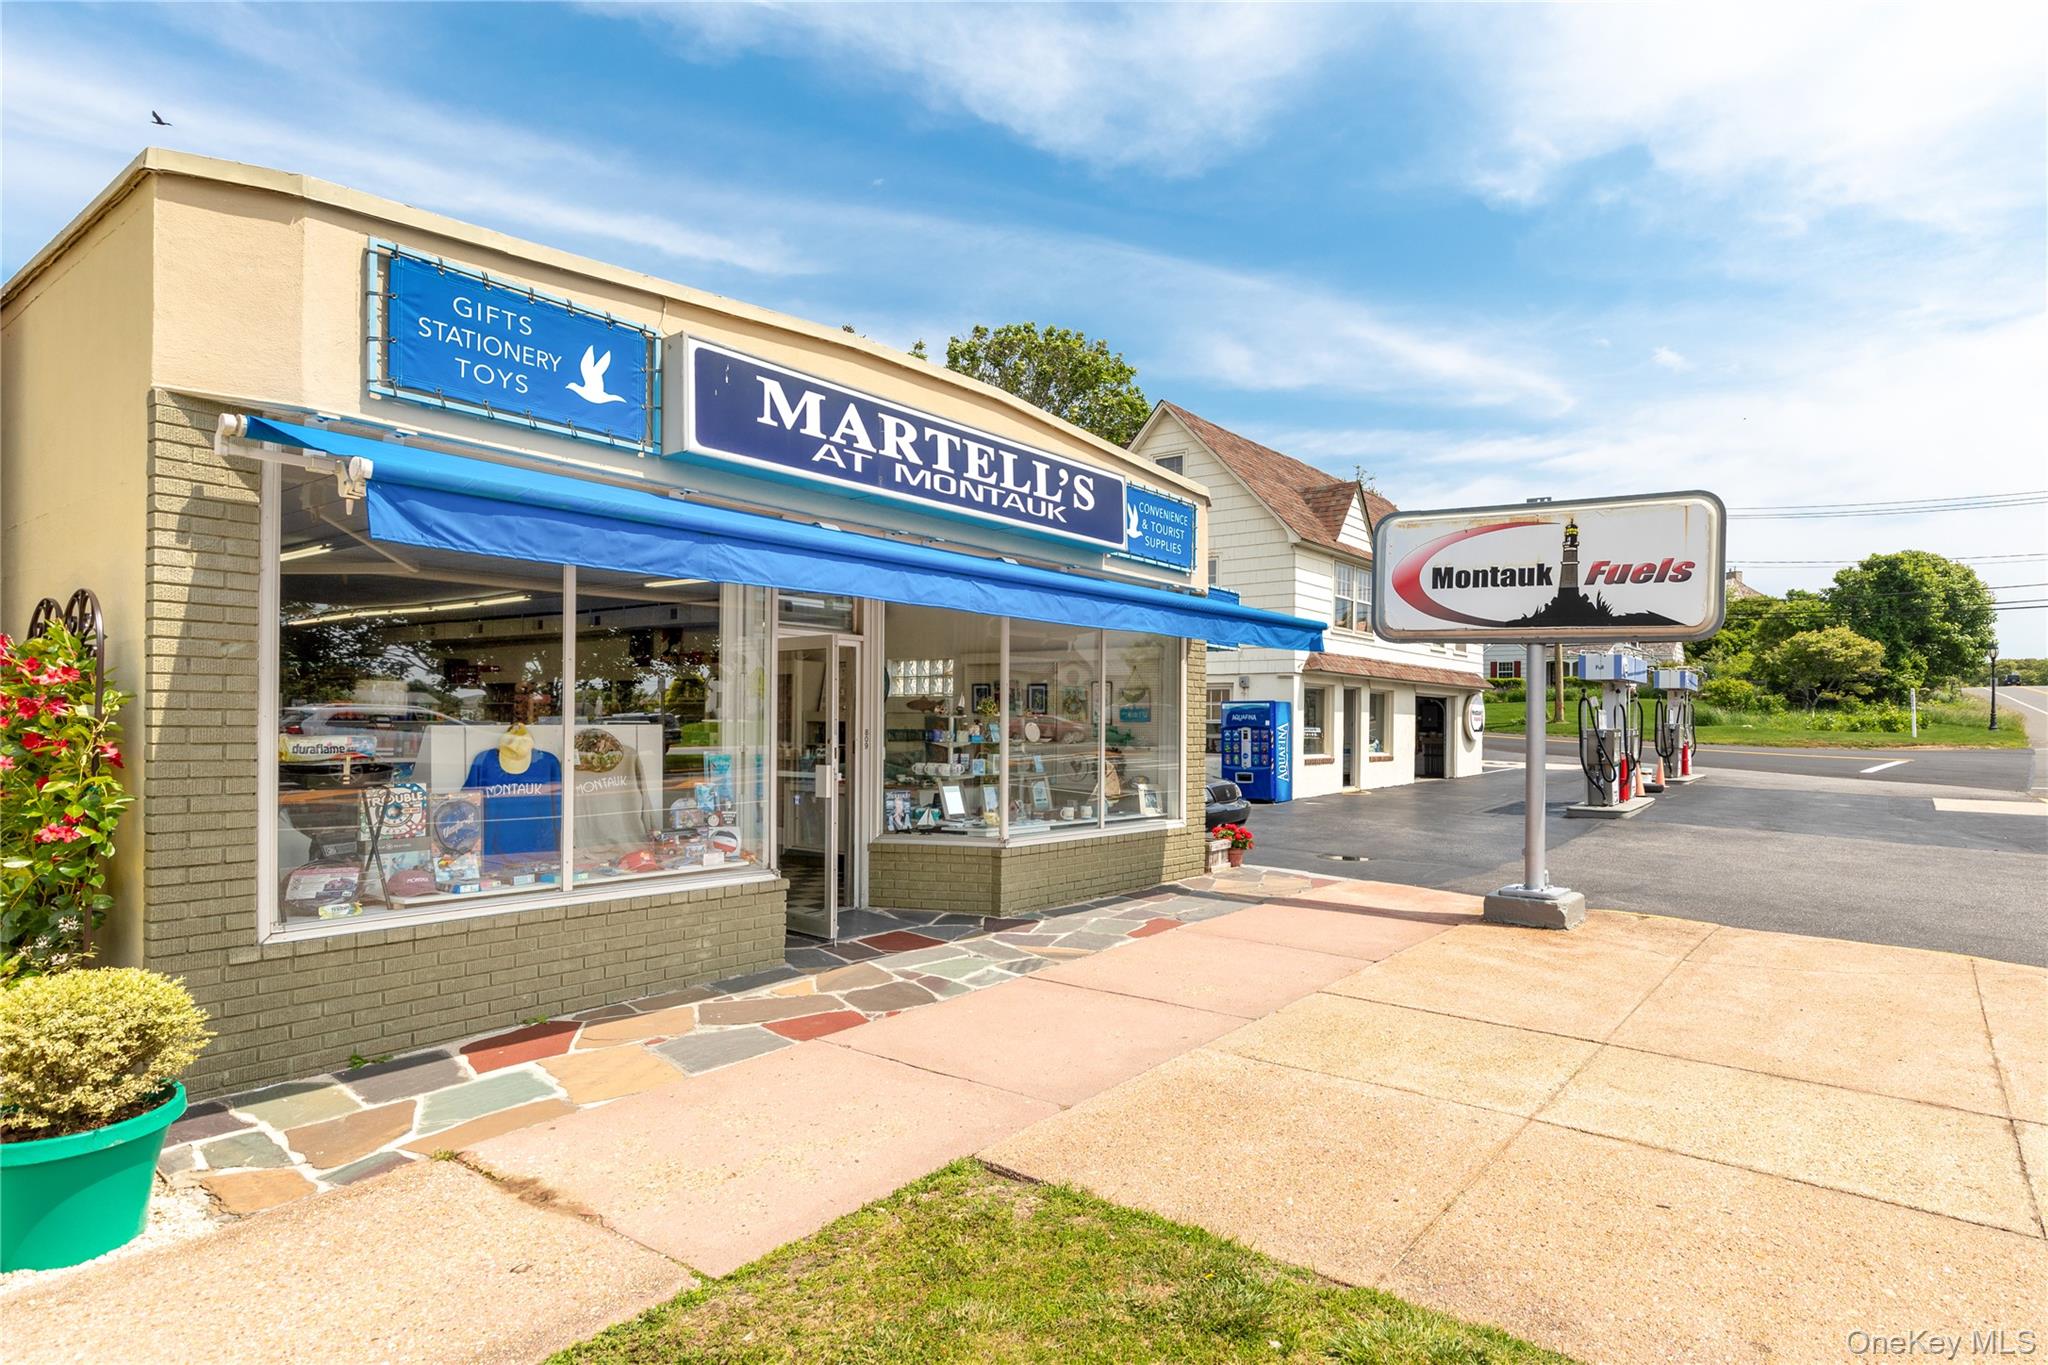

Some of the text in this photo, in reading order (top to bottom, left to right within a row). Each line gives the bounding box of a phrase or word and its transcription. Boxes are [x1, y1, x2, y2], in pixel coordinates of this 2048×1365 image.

[452, 296, 533, 337] GIFTS
[417, 316, 563, 373] STATIONERY
[454, 356, 529, 394] TOYS
[756, 375, 1096, 512] MARTELL'S
[811, 443, 1068, 524] AT MONTAUK
[1138, 501, 1189, 527] CONVENIENCE
[1141, 518, 1185, 540] & TOURIST
[1144, 535, 1182, 555] SUPPLIES
[1431, 557, 1696, 590] Montauk Fuels
[1231, 713, 1257, 722] AQUAFINA
[291, 743, 346, 755] duraflame
[1277, 722, 1290, 782] AQUAFINA
[485, 782, 544, 799] MONTAUK
[576, 775, 628, 795] MONTAUK
